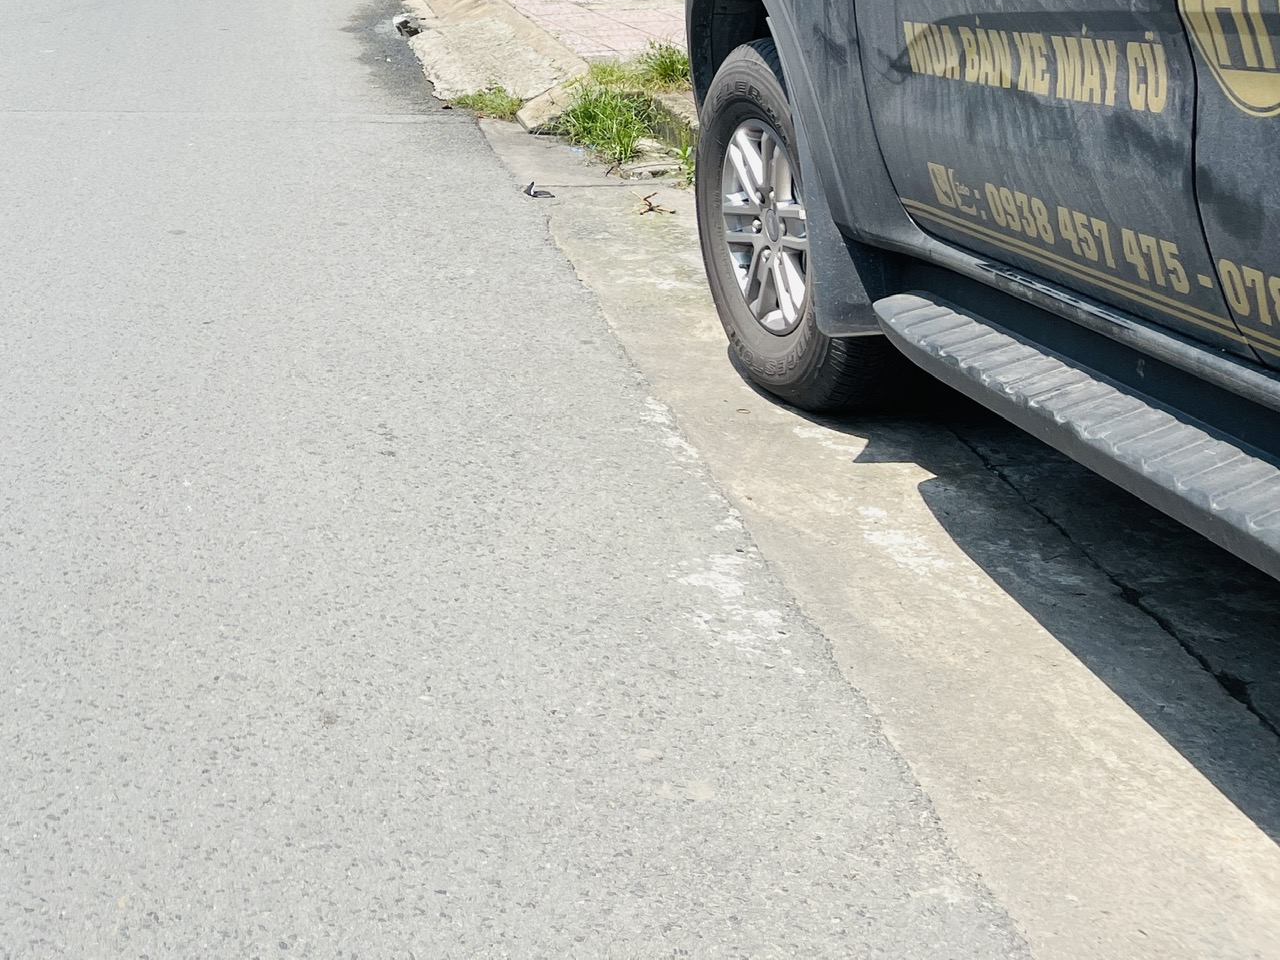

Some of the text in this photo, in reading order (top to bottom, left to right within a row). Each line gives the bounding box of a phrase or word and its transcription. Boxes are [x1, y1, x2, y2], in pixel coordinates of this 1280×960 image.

[903, 16, 1169, 114] MUA BÁN XE MÁY CŨ
[985, 182, 1055, 245] 0938
[1057, 205, 1116, 270] 457
[1121, 227, 1190, 295] 475
